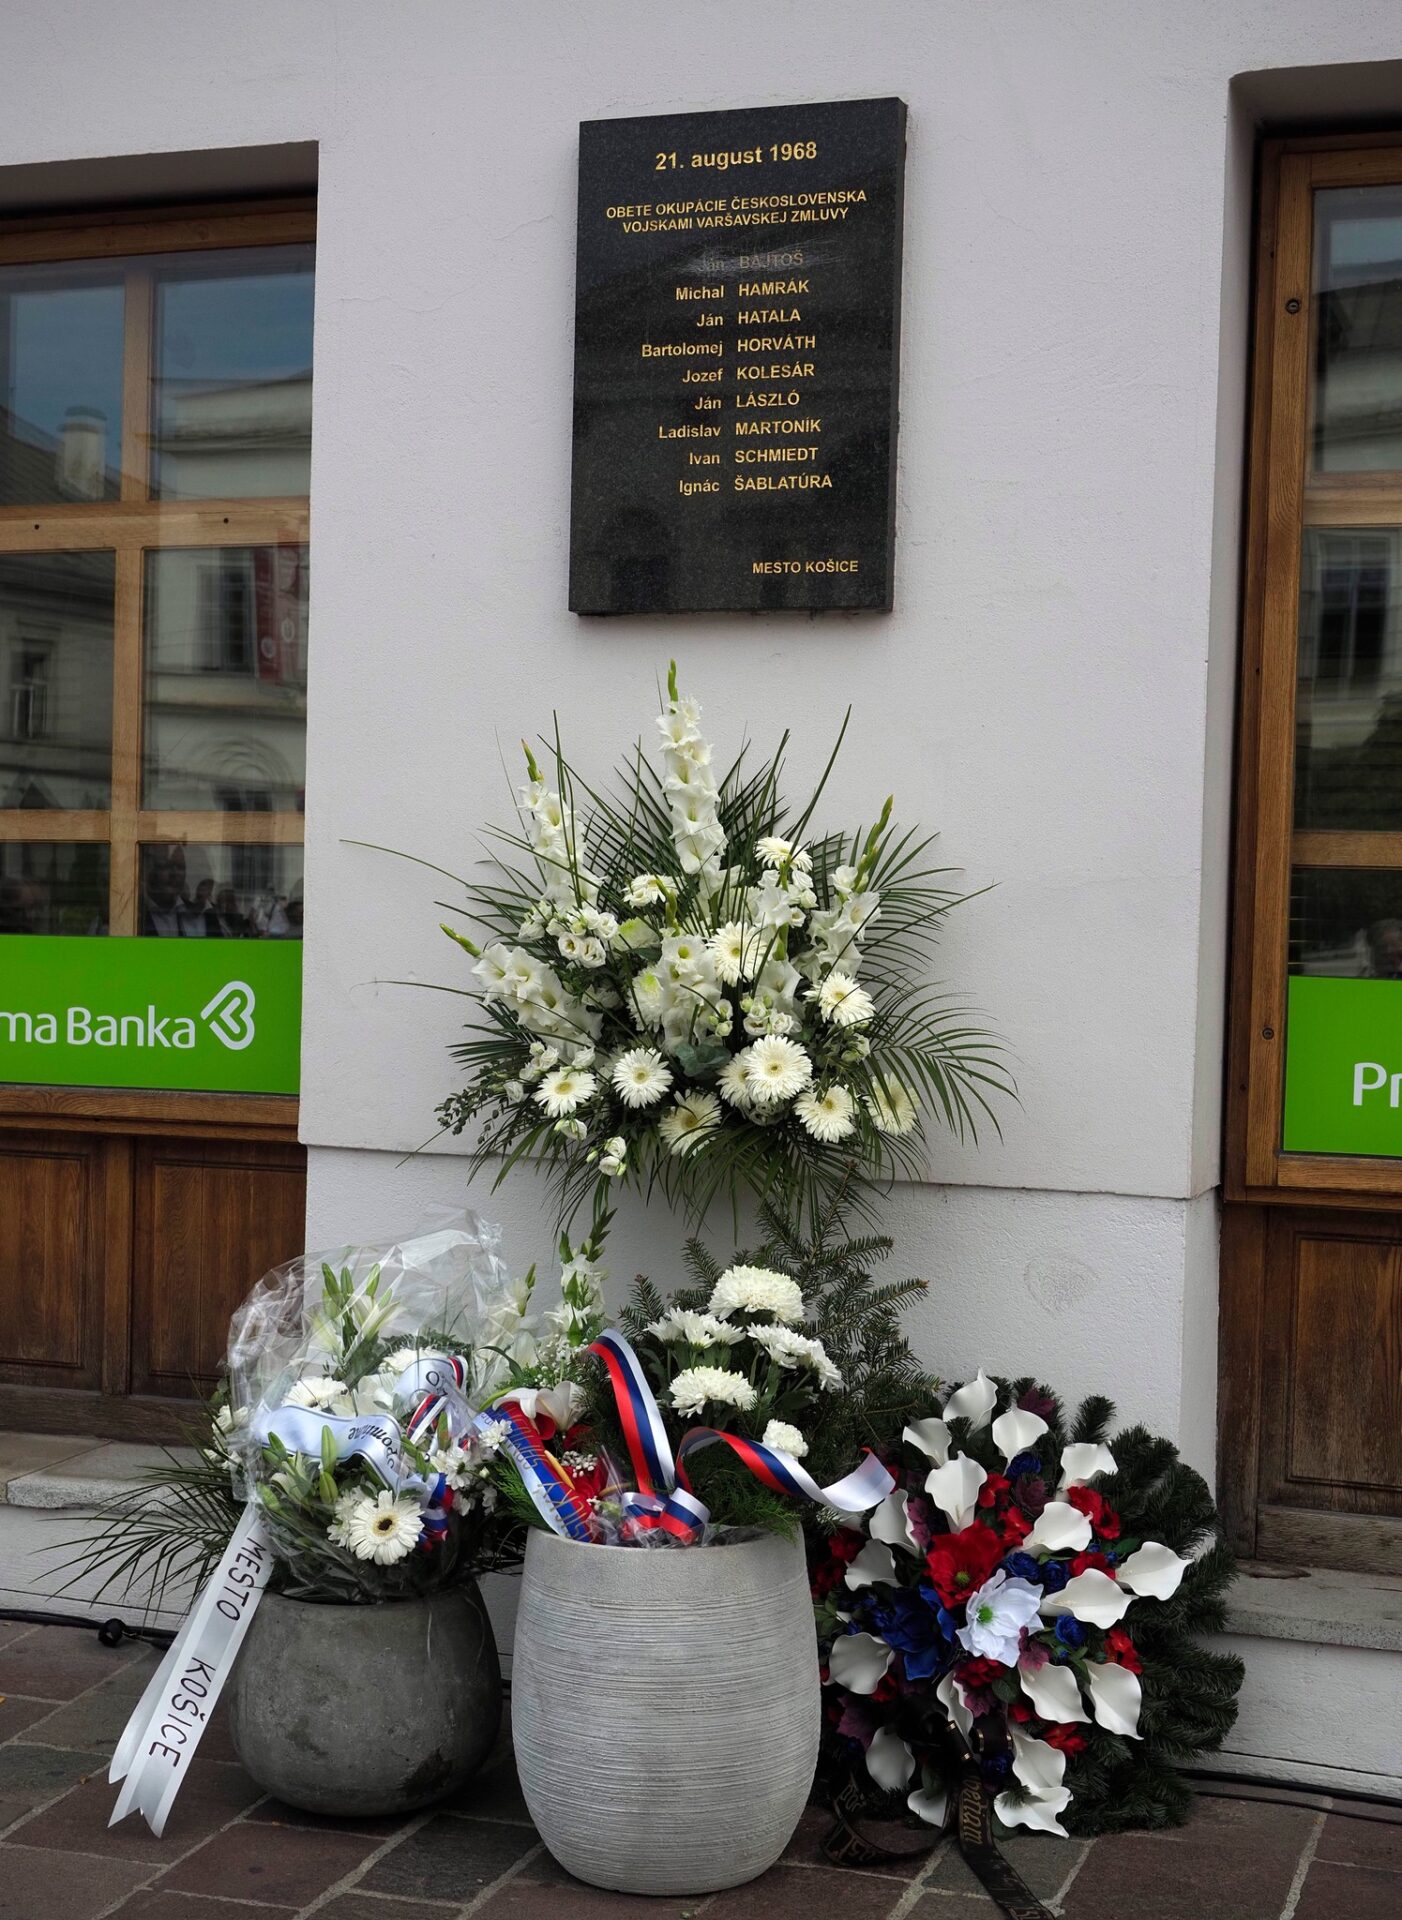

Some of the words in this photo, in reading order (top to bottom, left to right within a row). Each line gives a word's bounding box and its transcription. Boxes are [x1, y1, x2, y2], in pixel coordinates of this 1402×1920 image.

[655, 152, 684, 170] 21.
[691, 147, 762, 172] august
[770, 141, 817, 162] 1968
[606, 203, 652, 219] OBETE
[656, 198, 726, 215] OKUPÁCIE
[731, 190, 867, 210] ČESKOSLOVENSKA
[623, 217, 692, 233] VOJSKAMI
[697, 210, 787, 228] VARŠAVSKEJ
[791, 208, 849, 222] ZMLUVY
[739, 249, 804, 269] BAJTOŠ
[676, 285, 724, 301] Michal
[739, 278, 810, 297] HAMRÁK
[696, 312, 724, 327] Ján
[738, 309, 801, 325] HATALA
[642, 341, 723, 358] Bartolomej
[737, 334, 816, 353] HORVÁTH
[682, 369, 723, 384] Jozef
[737, 362, 815, 380] KOLESÁR
[694, 395, 722, 410] Ján
[736, 389, 800, 408] LÁSZLÓ
[658, 424, 721, 439] Ladislav
[735, 417, 822, 436] MARTONÍK
[689, 451, 721, 465] Ivan
[735, 447, 818, 463] SCHMIEDT
[679, 478, 720, 496] Ignác
[734, 473, 832, 491] ŠABLATÚRA
[752, 562, 801, 574] MESTO
[805, 558, 858, 573] KOŠICE
[66, 1004, 196, 1049] Banka
[216, 1537, 268, 1622] MESTO
[148, 1656, 217, 1768] KOŠICE
